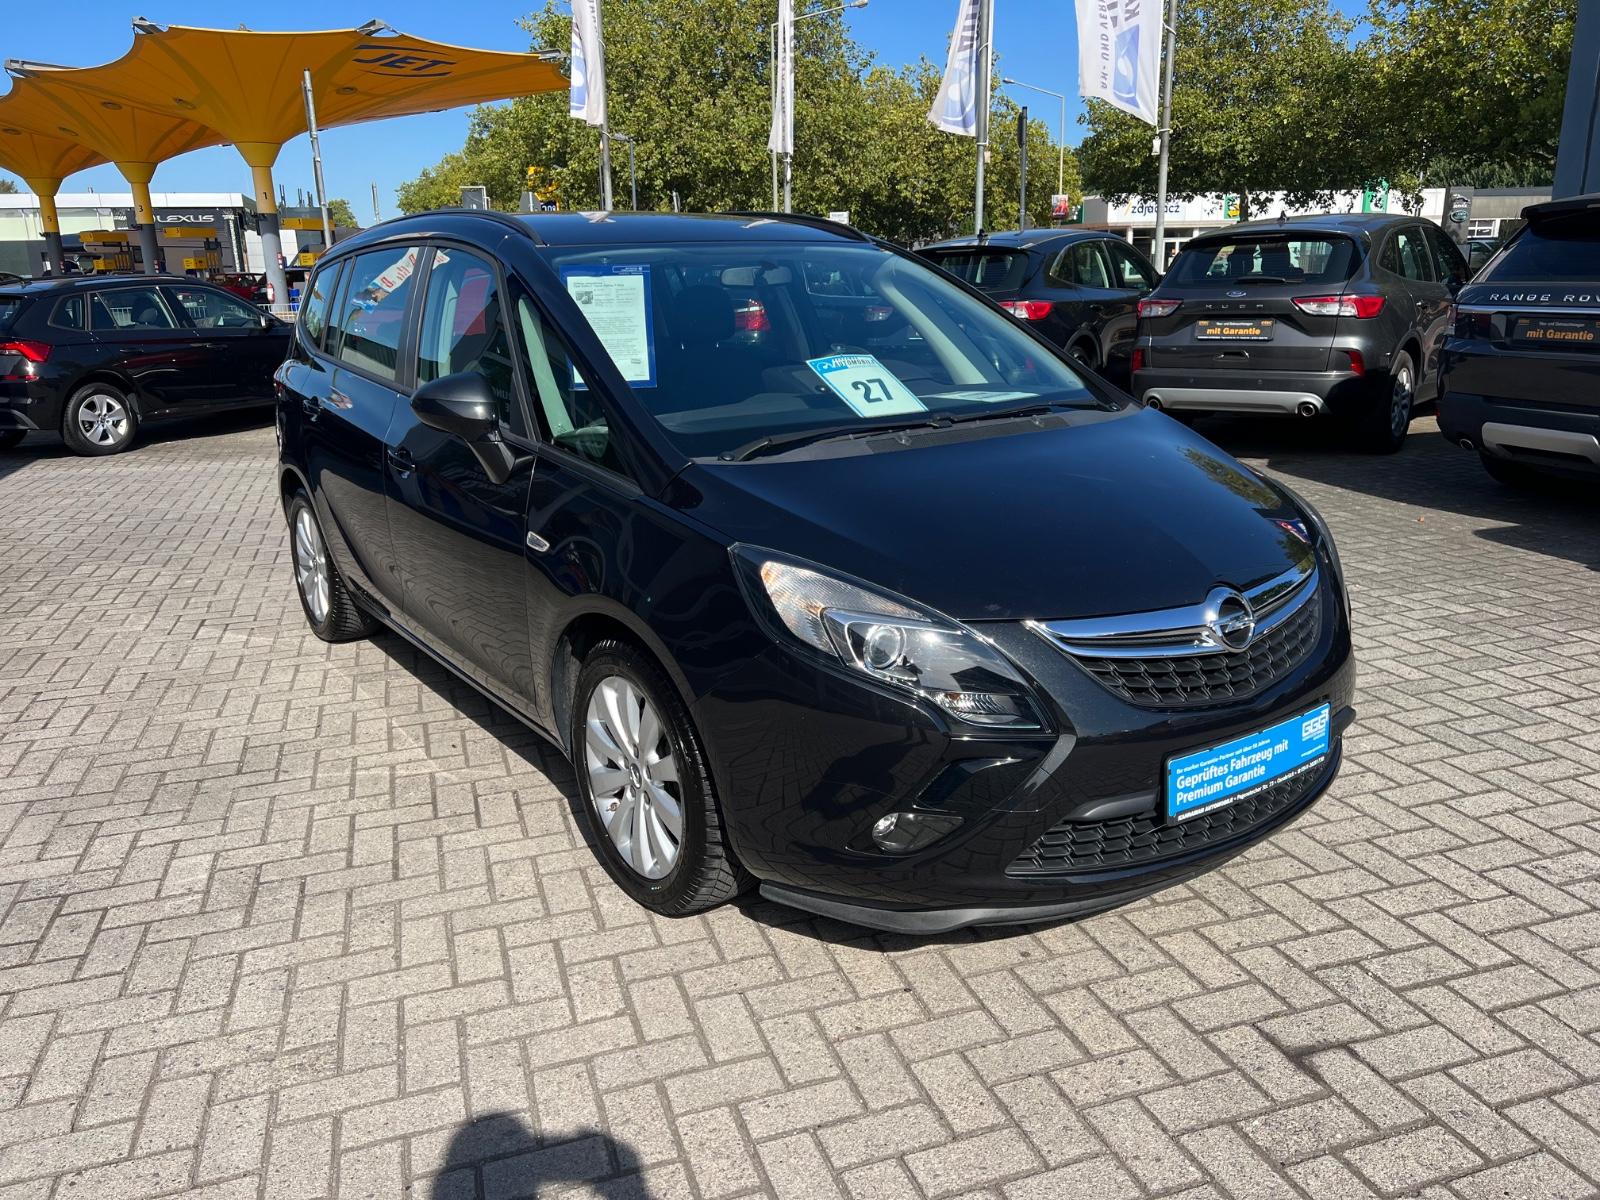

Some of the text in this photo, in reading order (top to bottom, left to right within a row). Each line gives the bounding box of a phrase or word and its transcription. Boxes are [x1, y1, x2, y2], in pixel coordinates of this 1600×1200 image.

[352, 53, 457, 72] JET
[263, 191, 268, 200] 1
[138, 205, 144, 213] 3
[157, 214, 215, 223] LEXUS
[1489, 293, 1551, 301] RANGE
[1206, 327, 1262, 335] mit Garantie
[1526, 328, 1594, 340] mit Garantie
[851, 378, 894, 404] 27
[1176, 764, 1229, 789] Geprüftes
[1230, 747, 1273, 772] Fahrzeug
[1274, 739, 1289, 755] mit
[1176, 763, 1266, 806] Premium Garantie
